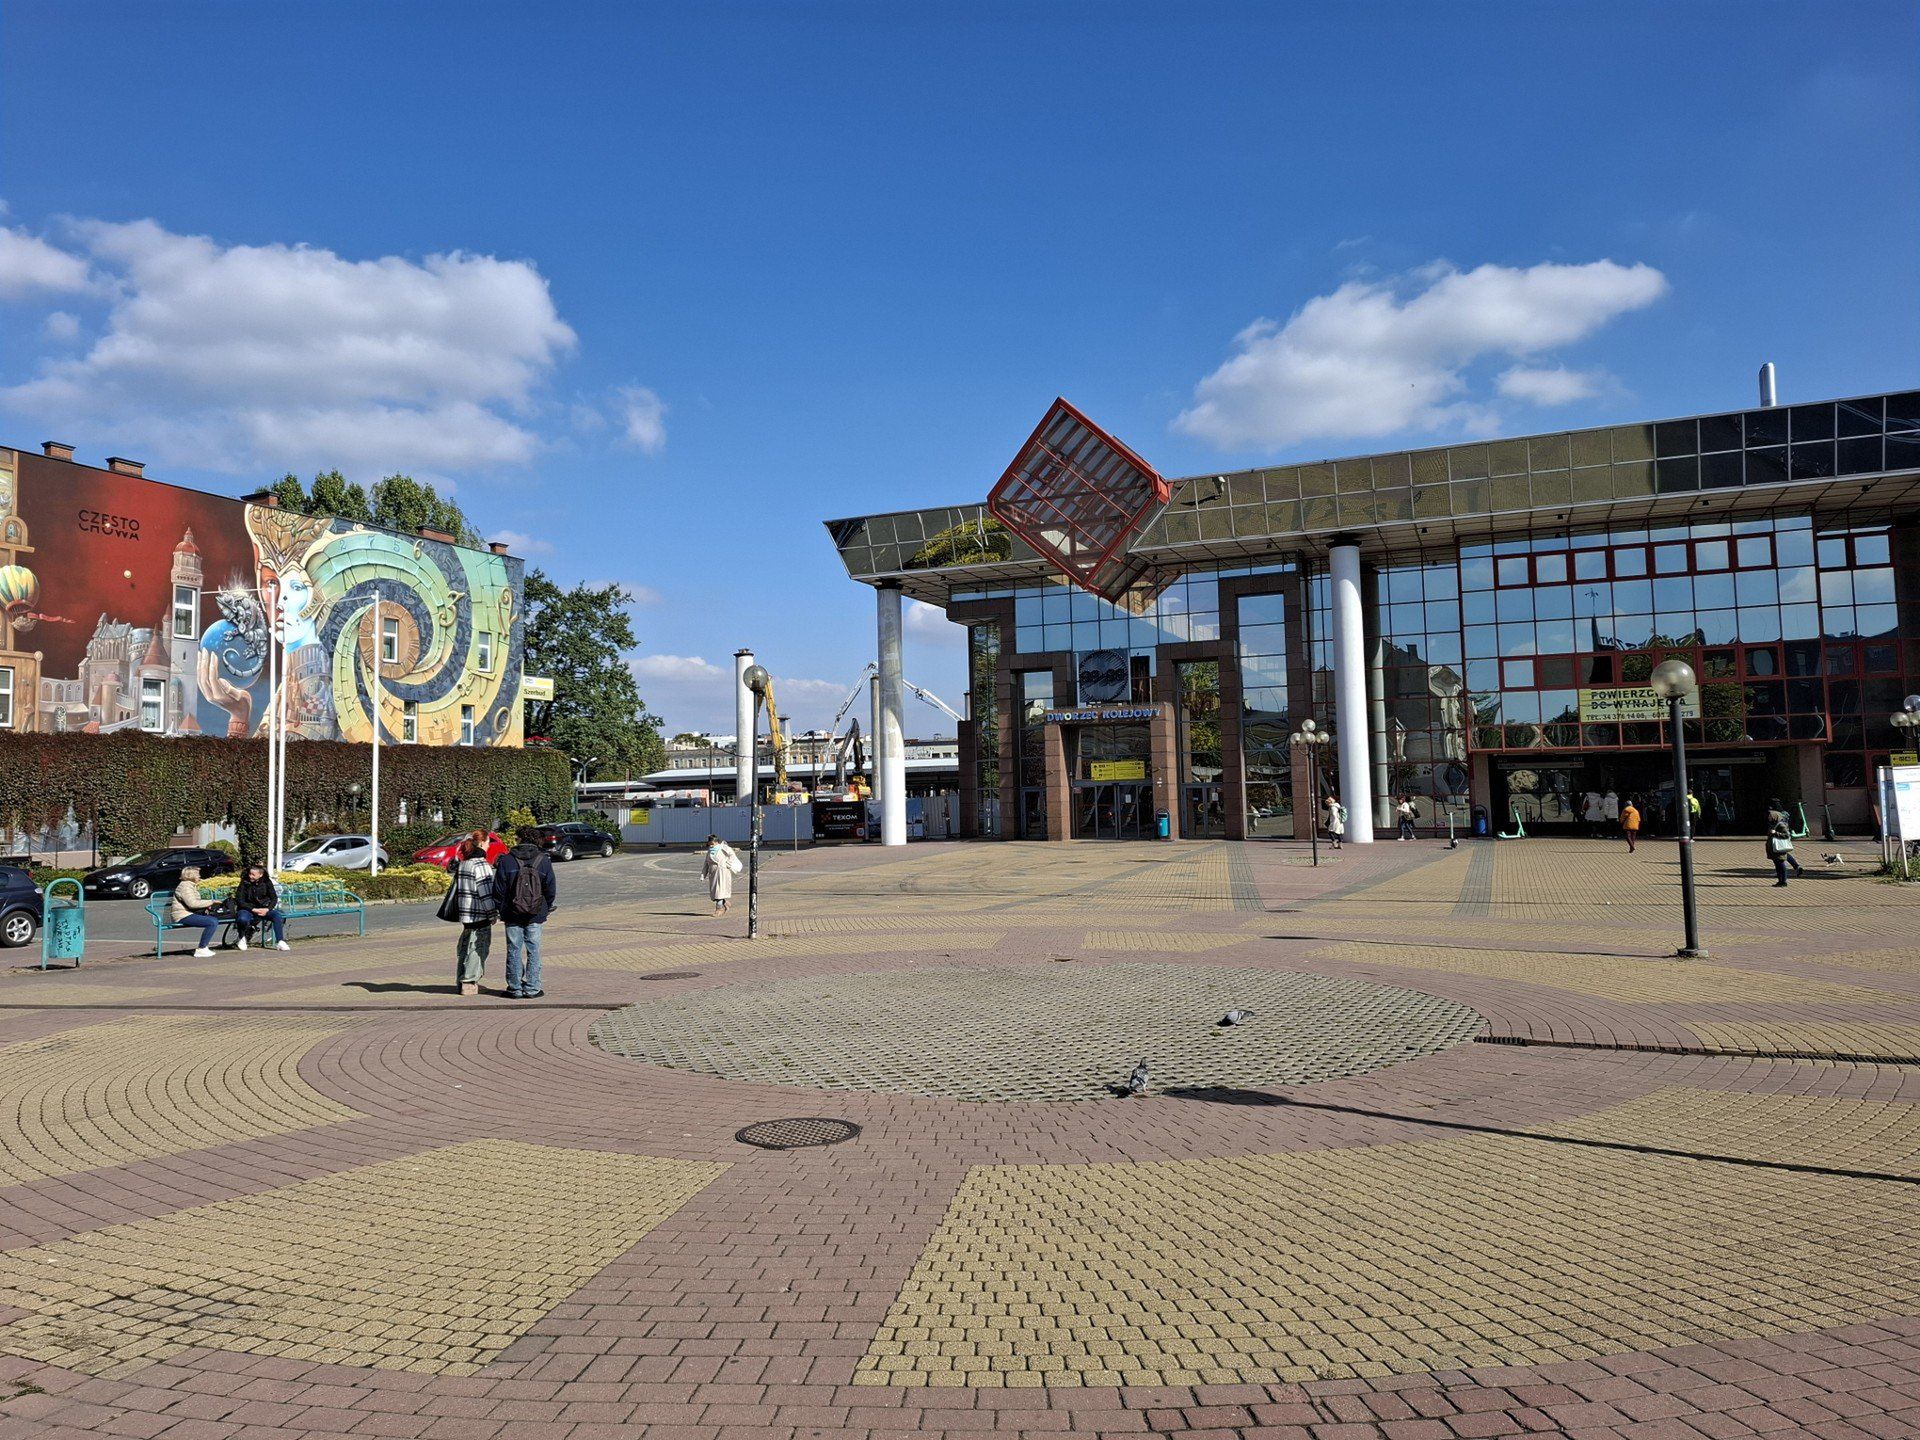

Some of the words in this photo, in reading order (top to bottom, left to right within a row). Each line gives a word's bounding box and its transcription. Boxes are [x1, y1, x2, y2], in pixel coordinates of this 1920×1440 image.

[367, 534, 376, 549] 7
[413, 539, 424, 561] 6
[438, 590, 465, 627] 3
[1591, 689, 1659, 700] POWIERZC
[1591, 701, 1609, 710] DO
[1613, 698, 1686, 709] WYNAJĘCA
[1046, 711, 1099, 722] DWORZEC
[1102, 708, 1161, 719] KOLEJOWY
